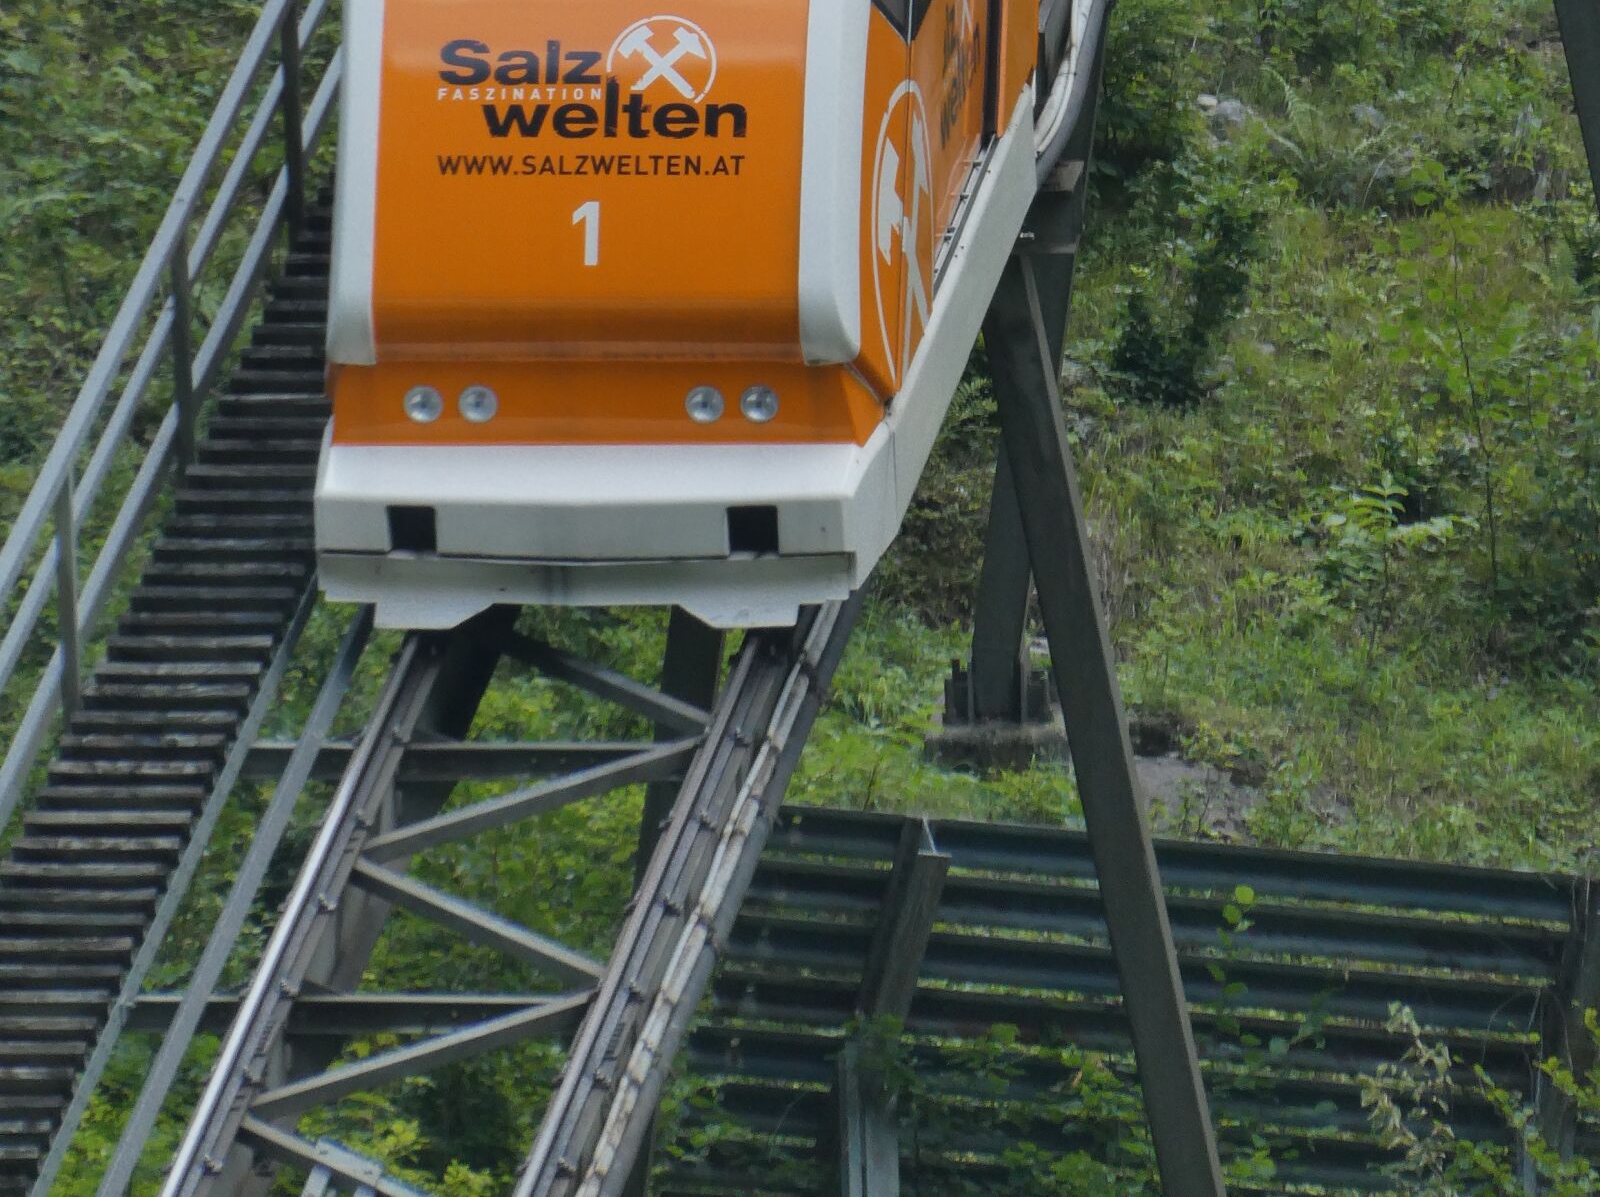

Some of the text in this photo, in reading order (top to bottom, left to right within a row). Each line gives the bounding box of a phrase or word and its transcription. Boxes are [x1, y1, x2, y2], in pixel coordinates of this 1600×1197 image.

[438, 39, 604, 85] Salz
[437, 88, 602, 101] FASZINATION
[481, 72, 748, 139] welten
[437, 155, 746, 176] WWW.SALZWELTEN.AT
[572, 201, 600, 266] 1
